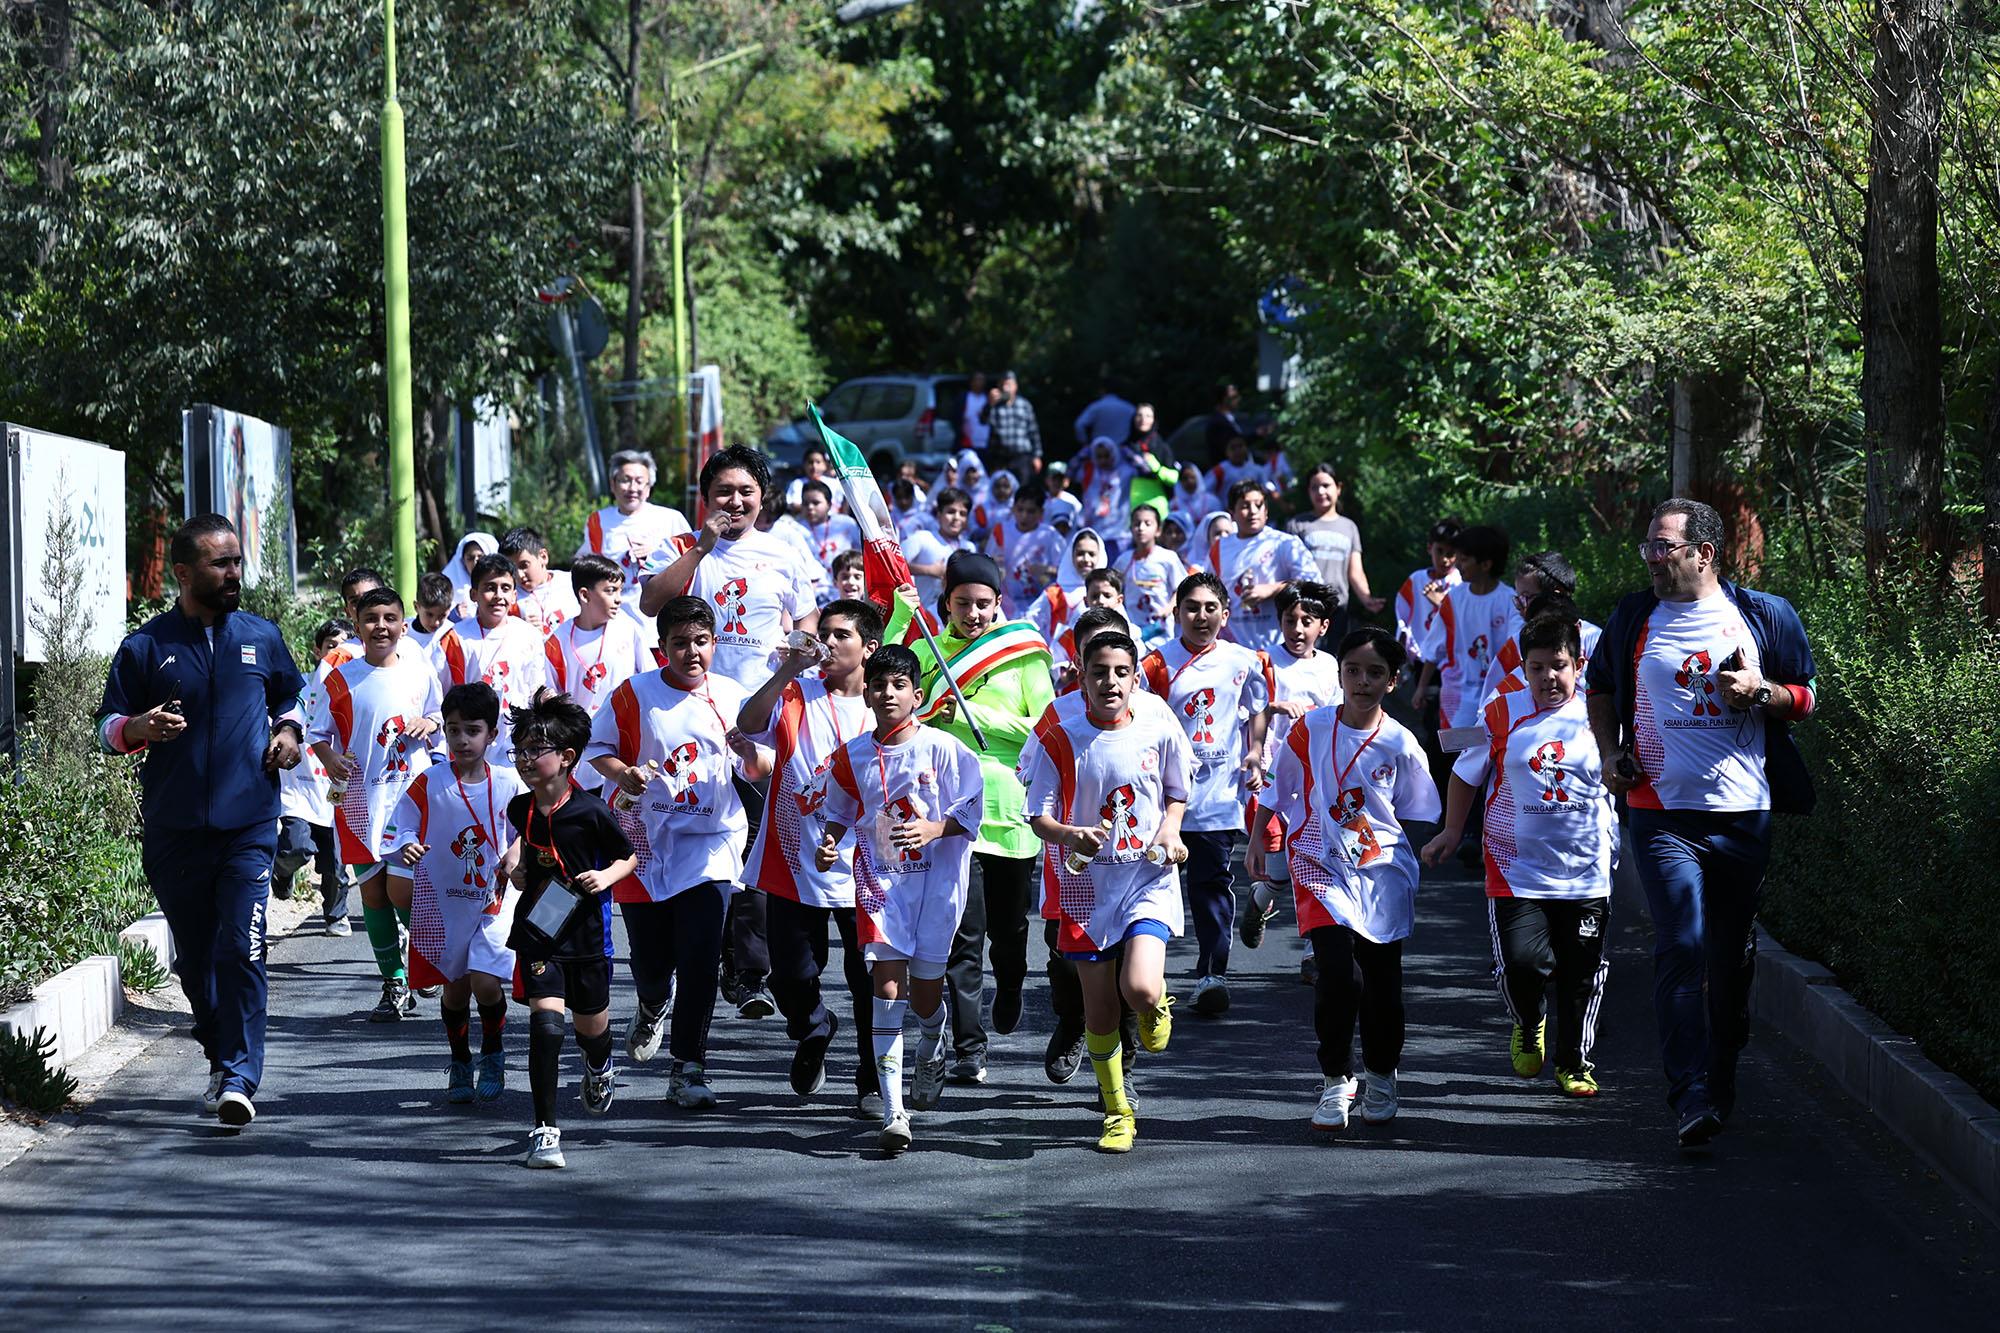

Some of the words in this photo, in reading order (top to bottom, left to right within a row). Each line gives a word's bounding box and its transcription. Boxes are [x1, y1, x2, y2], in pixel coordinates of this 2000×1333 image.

[1663, 719, 1682, 727] ASIAN
[1683, 719, 1707, 727] GAMES
[1709, 719, 1723, 727] FUN
[651, 802, 669, 811] ASIAN
[670, 804, 688, 812] GAMES
[688, 805, 701, 813] FUN
[702, 807, 714, 815] RUN
[1523, 804, 1539, 812] ASIAN
[1540, 804, 1562, 812] GAMES
[1564, 803, 1577, 811] FUN
[1093, 855, 1108, 863] ASIAN
[1108, 853, 1132, 863] GAMES
[874, 864, 892, 872] ASIAN
[446, 888, 462, 896] ASIAN
